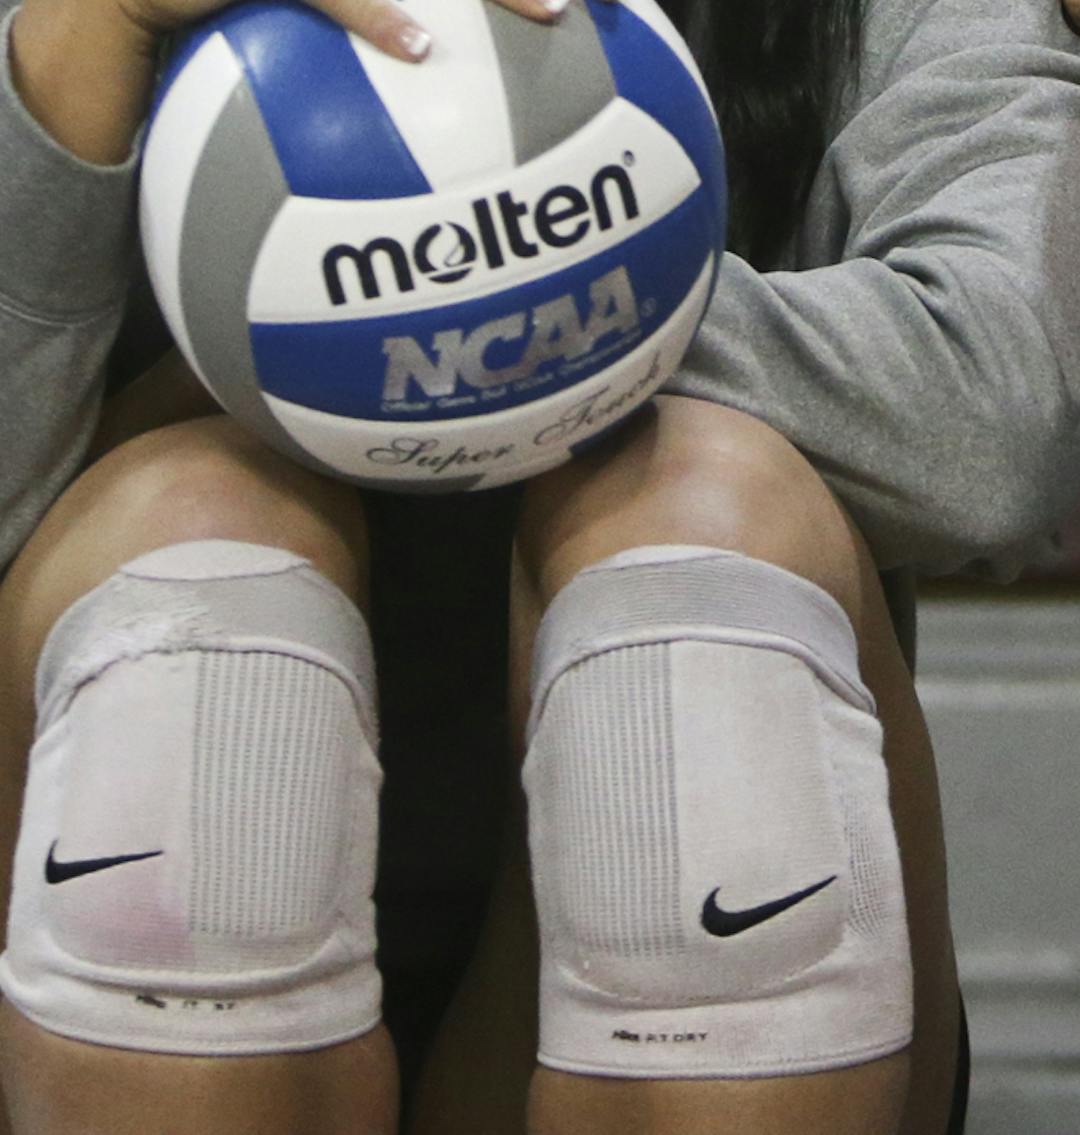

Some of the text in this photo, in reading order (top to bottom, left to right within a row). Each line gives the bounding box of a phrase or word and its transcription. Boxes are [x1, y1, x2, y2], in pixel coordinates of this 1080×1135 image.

[321, 163, 640, 306] molten
[382, 265, 640, 401] NCAA
[366, 436, 516, 474] Super
